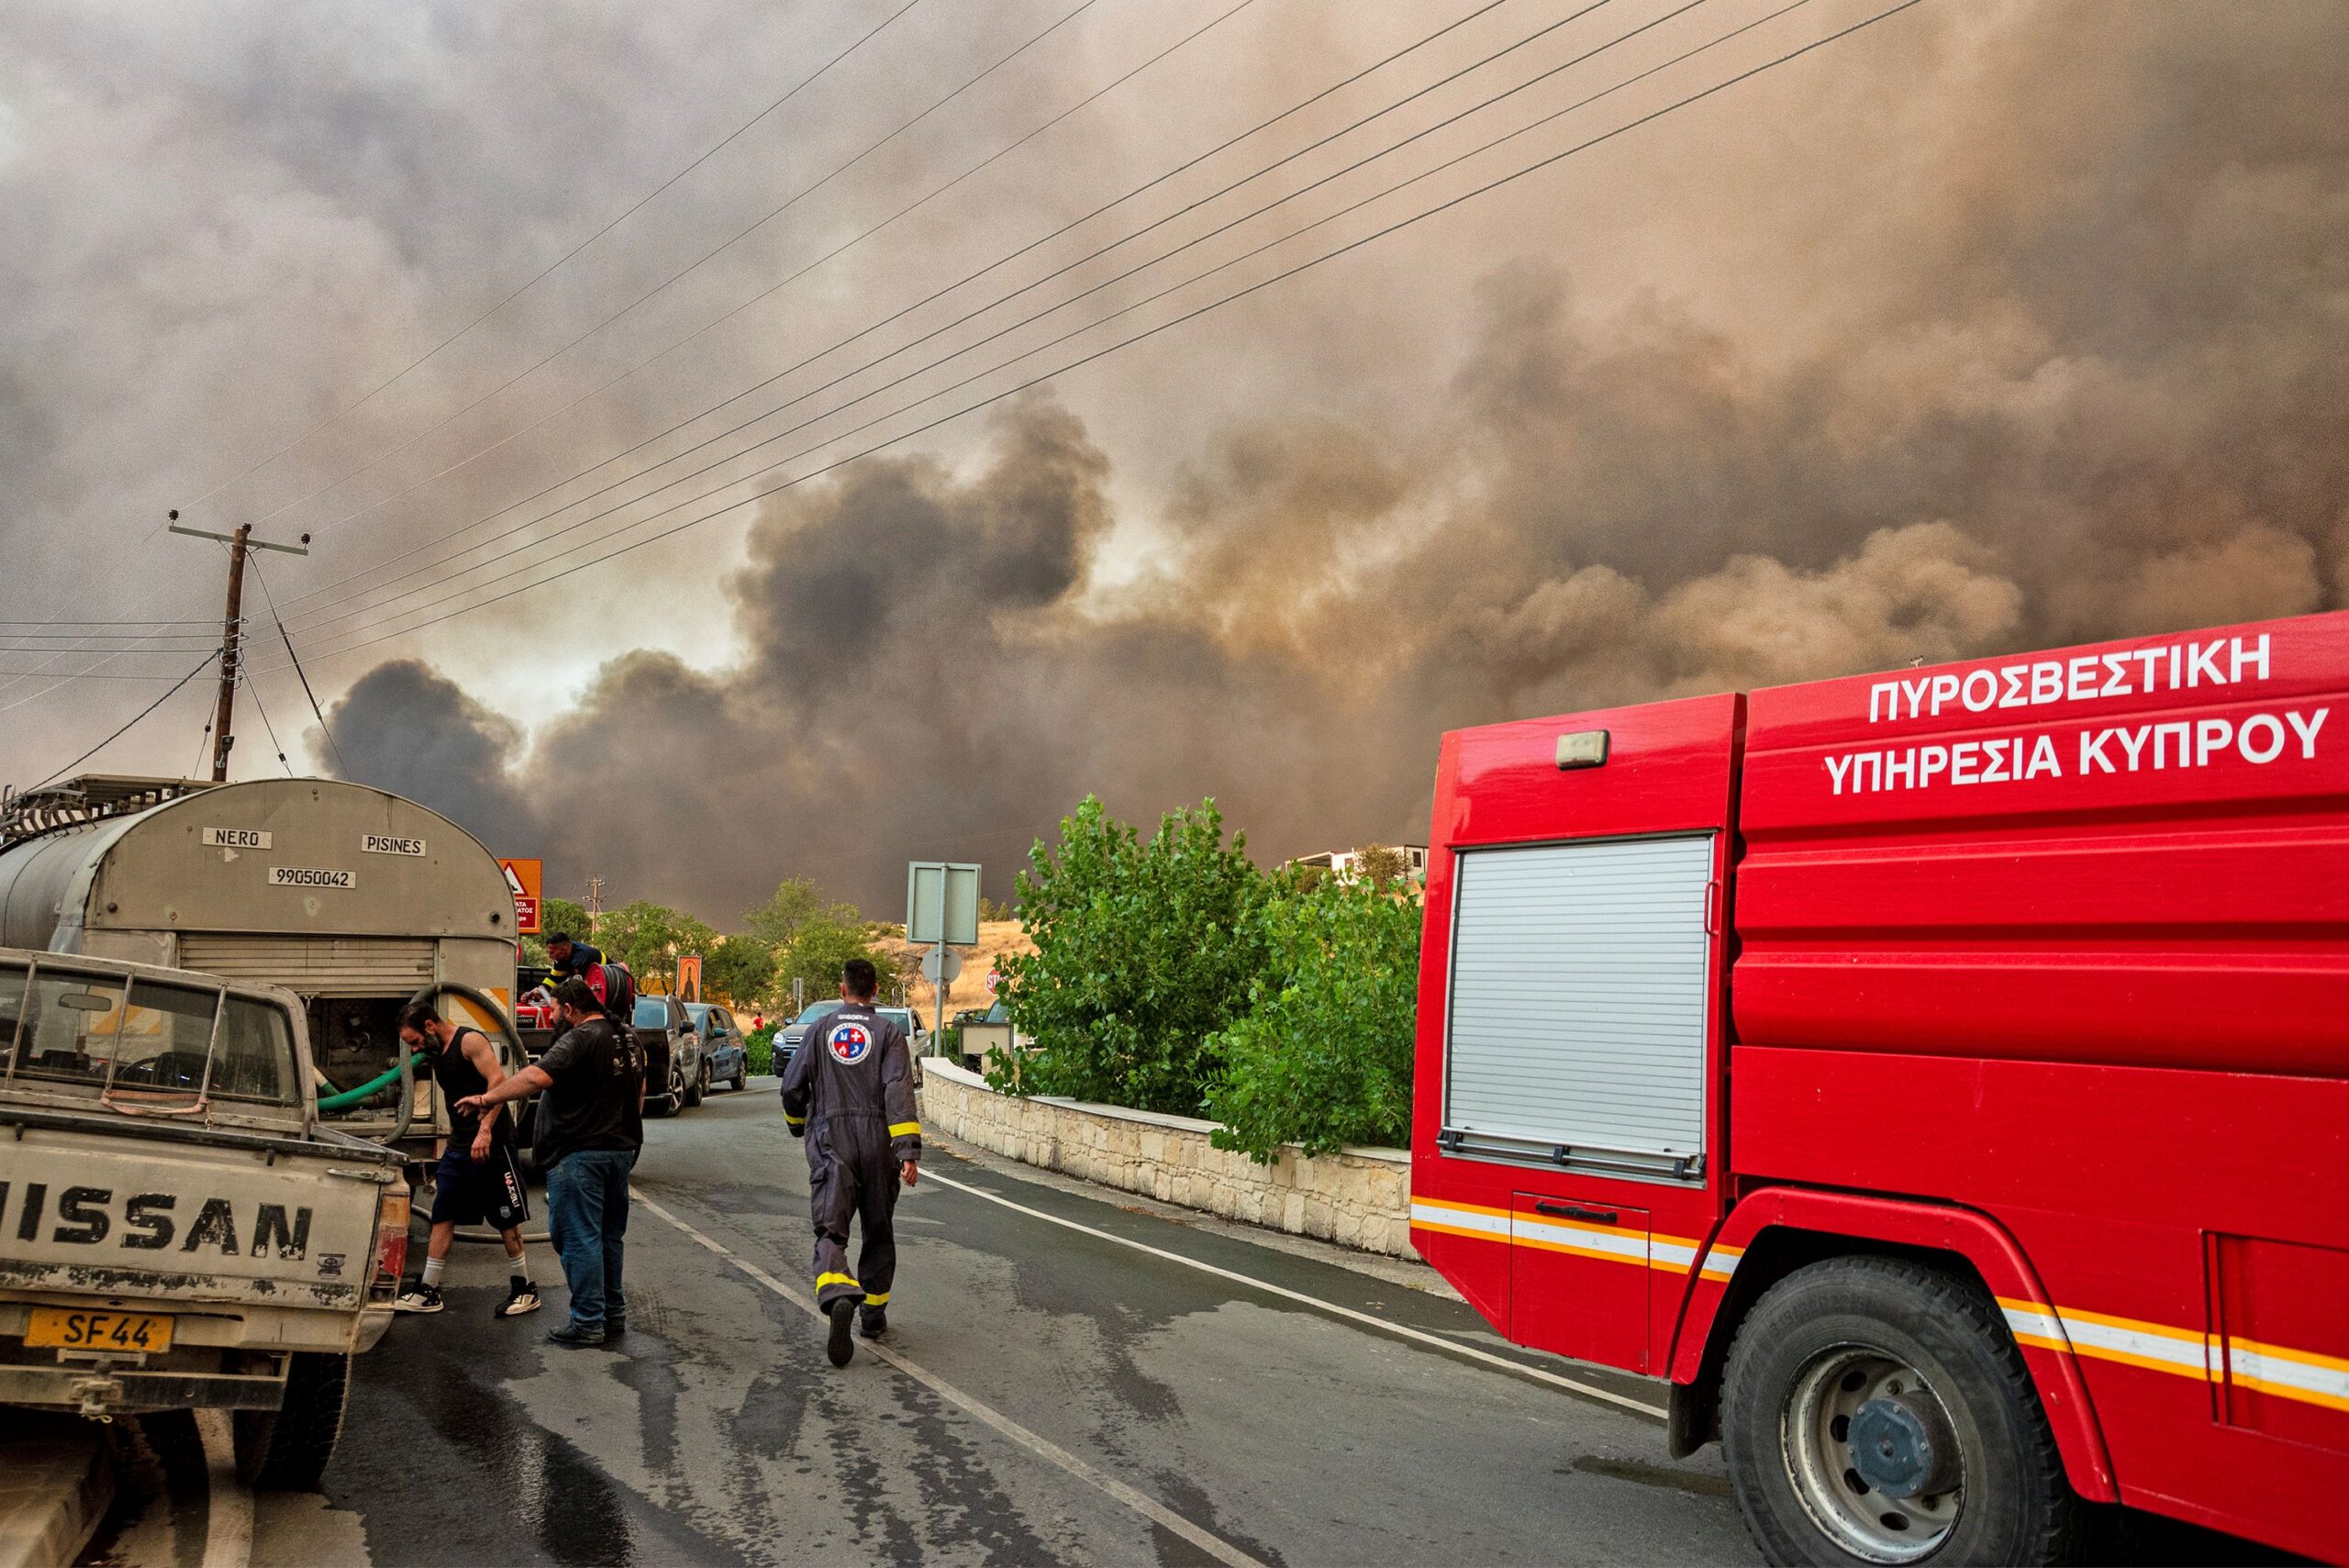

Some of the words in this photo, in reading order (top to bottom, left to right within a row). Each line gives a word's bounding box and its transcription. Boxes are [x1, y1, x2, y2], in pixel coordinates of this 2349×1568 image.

[1869, 634, 2270, 723] ΠΥΡΟΣΒΕΣΤΙΚΗ
[1824, 735, 2062, 795] ΥΠΗΡΕΣΙΑ
[2080, 708, 2330, 775] ΚΥΠΡΟΥ
[216, 829, 259, 846] NERO
[367, 836, 420, 854] PISINES
[277, 869, 349, 886] 99050042
[0, 1181, 314, 1261] ISSAN
